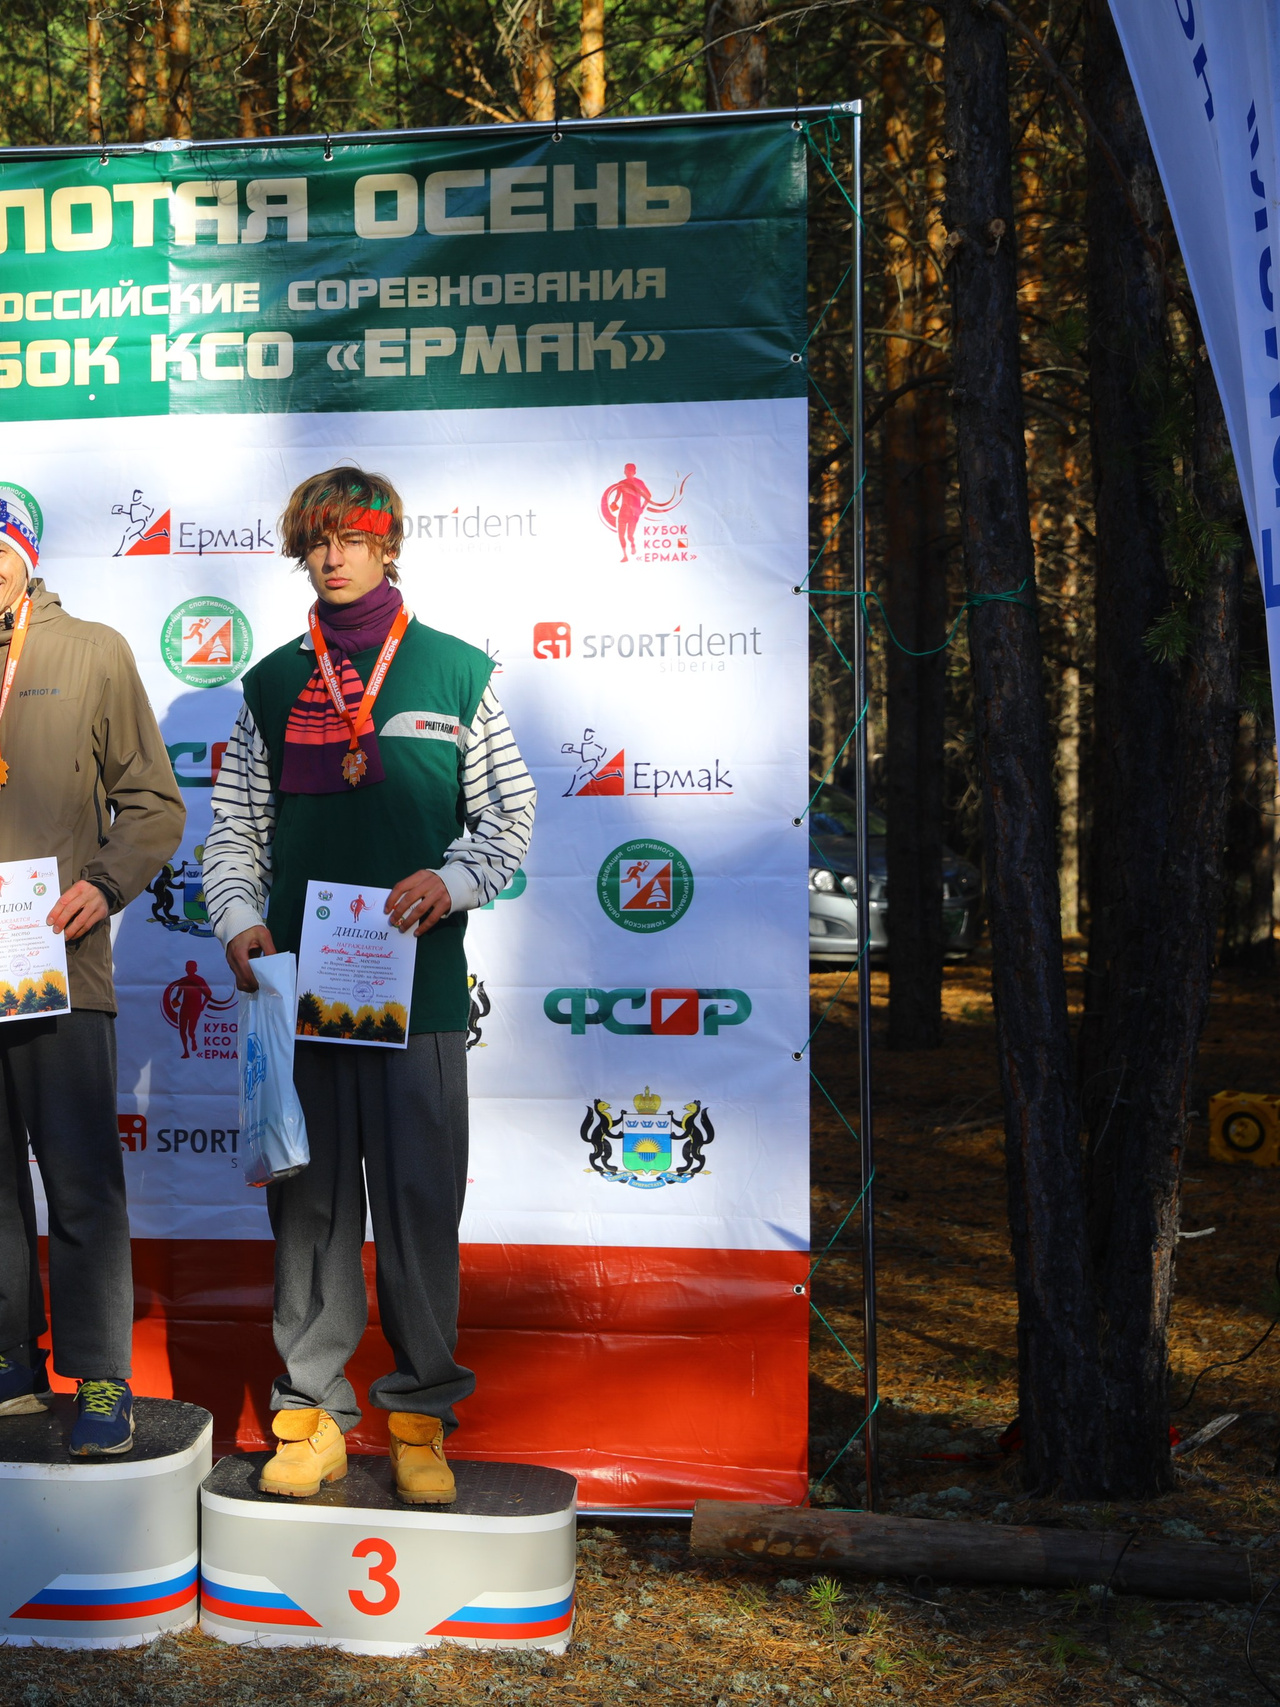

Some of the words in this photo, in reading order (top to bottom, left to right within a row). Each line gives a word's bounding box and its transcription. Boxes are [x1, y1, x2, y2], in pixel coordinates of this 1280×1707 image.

[354, 161, 692, 239] ОСЕНЬ
[287, 267, 667, 311] СОРЕВНОВАНИЯ
[150, 331, 294, 383] КСО
[326, 320, 666, 378] «ЕРМАК»
[179, 520, 275, 556] Ермак
[643, 525, 688, 536] КУБОК
[643, 539, 672, 549] КСО
[188, 600, 235, 615] СПОРТИВНОГО
[583, 624, 762, 658] SPORTident
[369, 662, 388, 697] ЗОЛОТАЯ
[384, 638, 399, 661] ОСЕНЬ
[660, 659, 725, 672] siberia
[19, 688, 49, 698] PATRIOT
[355, 753, 363, 765] 3
[633, 758, 733, 798] Ермак
[626, 843, 675, 858] СПОРТИВНОГО
[601, 851, 624, 887] ФЕДЕРАЦИЯ
[670, 860, 690, 919] ОРИЕНТИРОВАНИЯ
[602, 890, 620, 919] ОБЛАСТИ
[332, 926, 389, 941] ДИПЛОМ
[204, 1023, 238, 1034] КУБО
[204, 1036, 231, 1047] КСО
[196, 1049, 239, 1060] «ЕРМА
[348, 1537, 401, 1617] 3
